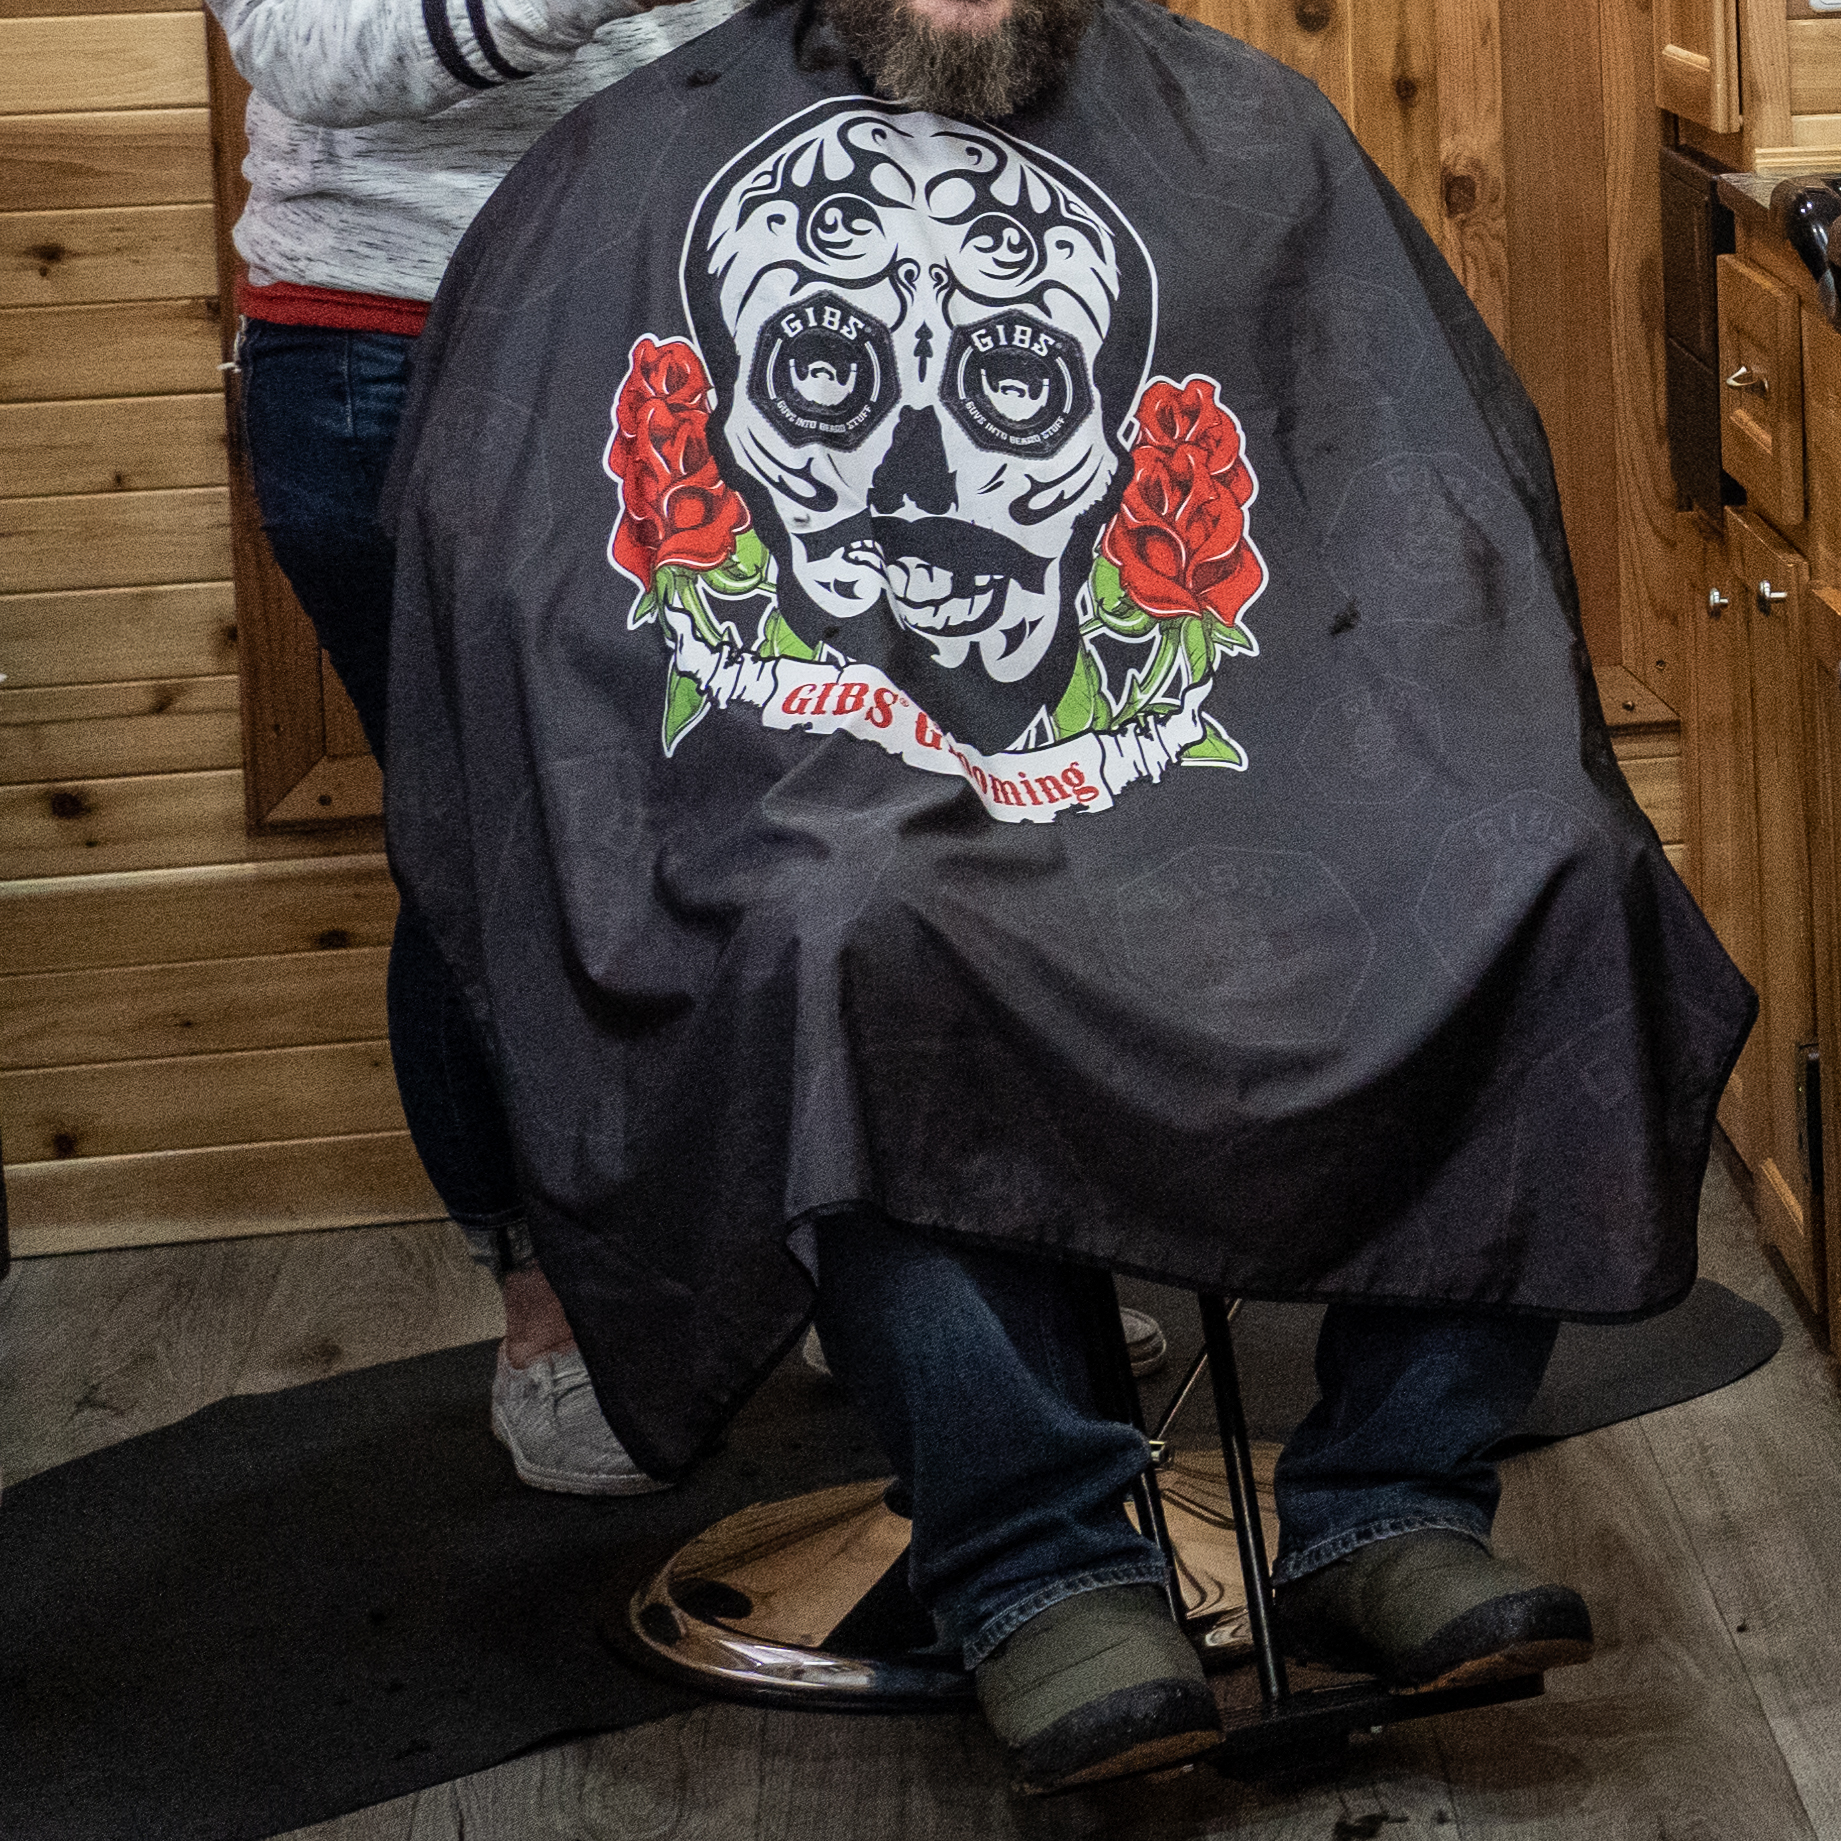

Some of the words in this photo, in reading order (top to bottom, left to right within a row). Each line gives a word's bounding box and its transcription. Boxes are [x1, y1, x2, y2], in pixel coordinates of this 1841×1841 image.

[847, 403, 873, 430] STUFF
[984, 422, 1008, 441] INTO
[1039, 415, 1066, 440] STUFF
[915, 711, 1100, 803] Gooming
